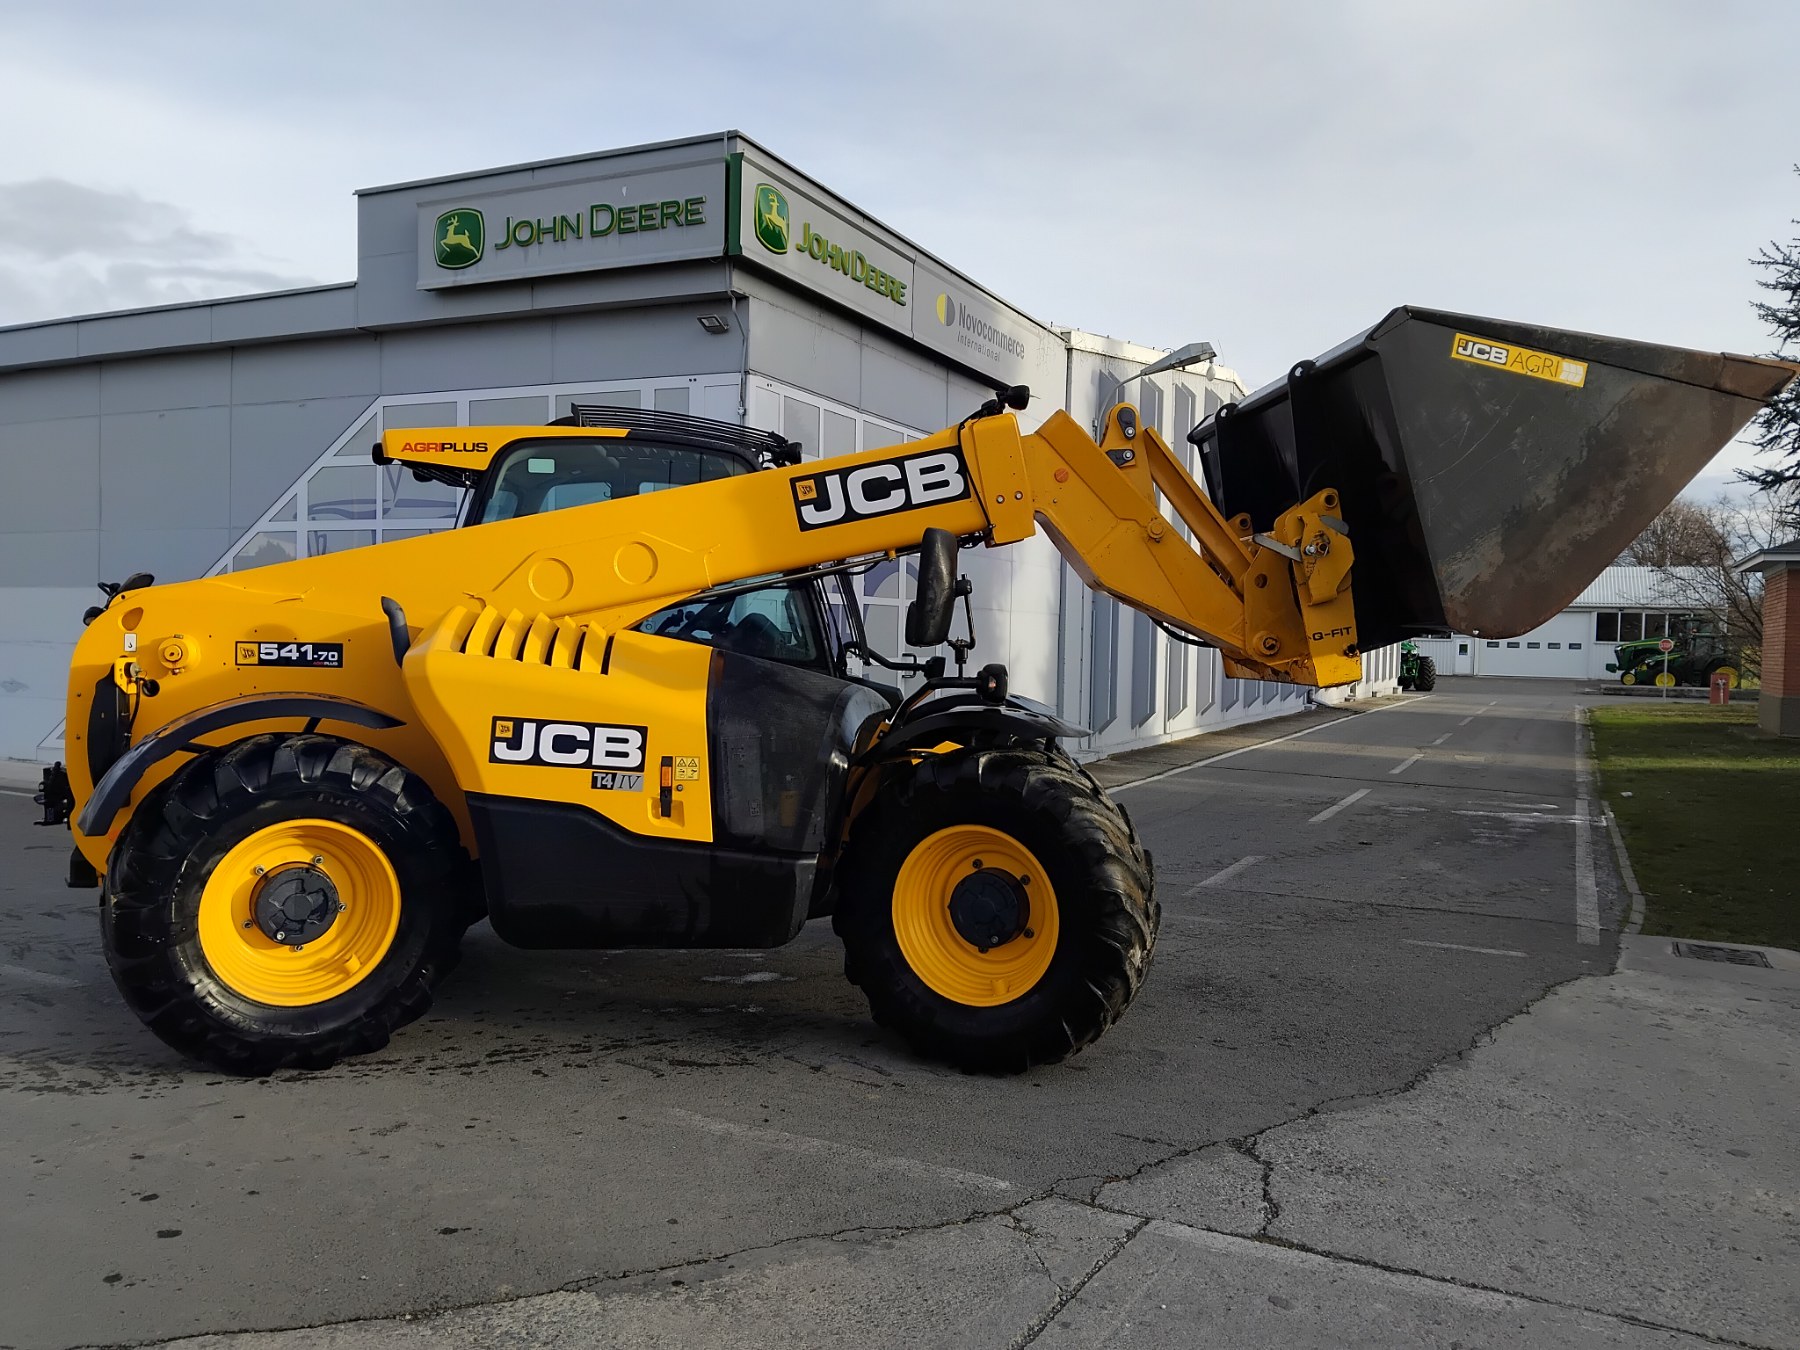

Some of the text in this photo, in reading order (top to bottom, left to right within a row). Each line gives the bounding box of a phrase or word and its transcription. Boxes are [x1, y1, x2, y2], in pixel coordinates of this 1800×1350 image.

[494, 195, 707, 250] JOHN DEERE
[796, 220, 908, 307] JOHN DEERE
[957, 331, 1001, 362] International
[959, 302, 1025, 360] Novocommerce
[1457, 341, 1560, 378] JCB AGRI
[401, 442, 488, 453] AGRIPLUS
[799, 453, 965, 525] JCB
[260, 643, 338, 661] 541-70
[1312, 627, 1352, 641] Q-FIT
[494, 721, 643, 768] JCB
[593, 772, 642, 790] T4 IV
